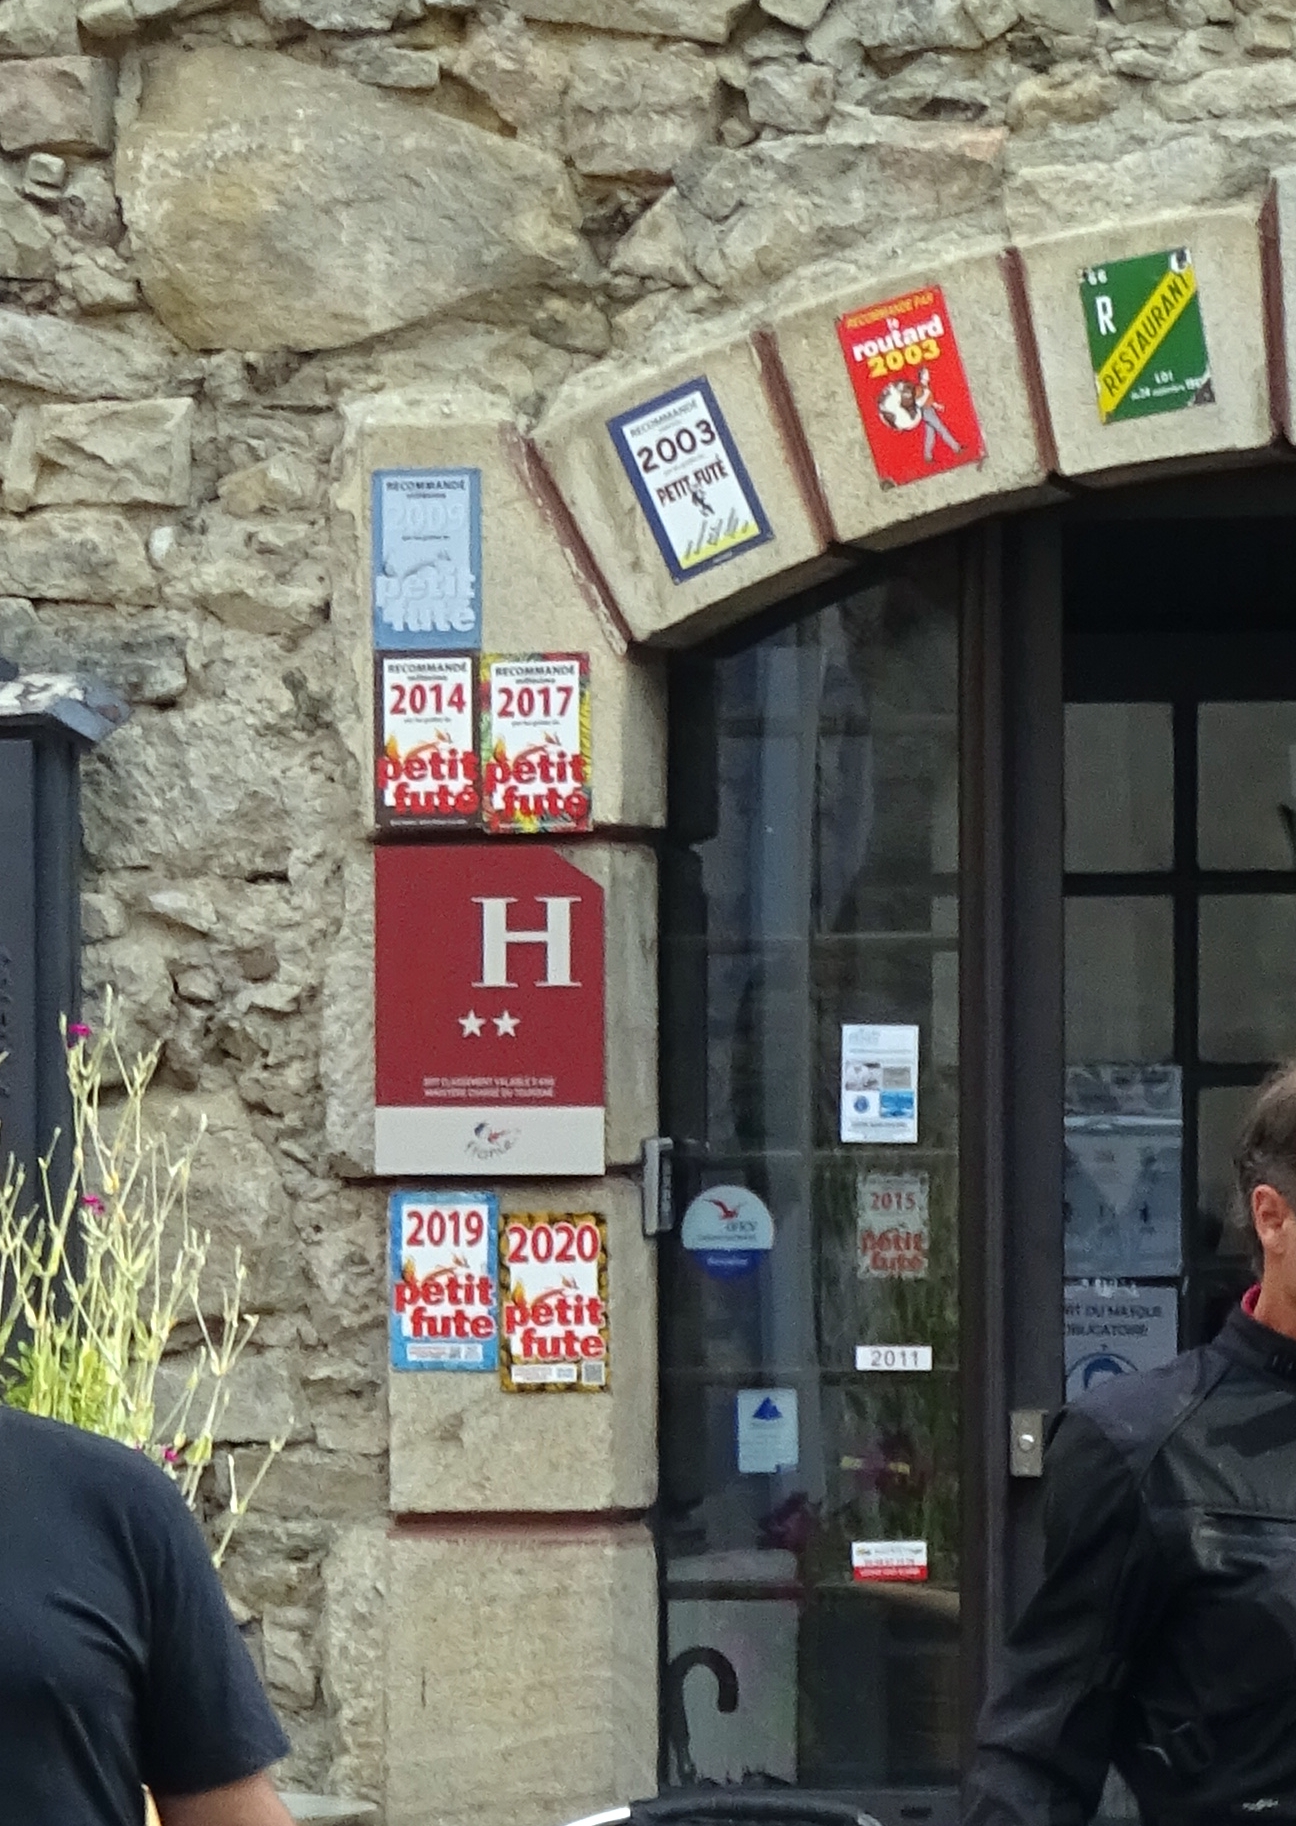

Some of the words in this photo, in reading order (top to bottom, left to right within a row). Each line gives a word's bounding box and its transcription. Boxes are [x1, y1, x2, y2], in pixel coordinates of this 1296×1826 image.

[1095, 296, 1117, 336] R
[1102, 274, 1190, 397] RESTAURANT
[852, 313, 945, 361] routard
[867, 339, 941, 379] 2003
[636, 420, 717, 473] 2003
[656, 474, 692, 508] PETIT
[376, 567, 476, 608] petit
[390, 682, 467, 716] 2014
[497, 685, 574, 718] 2017
[377, 749, 479, 789] petit
[484, 751, 586, 793] petit
[471, 896, 582, 988] H
[406, 1210, 484, 1248] 2019
[507, 1223, 600, 1263] 2020
[394, 1273, 494, 1313] petit
[505, 1295, 604, 1335] petit
[870, 1350, 919, 1368] 2011
